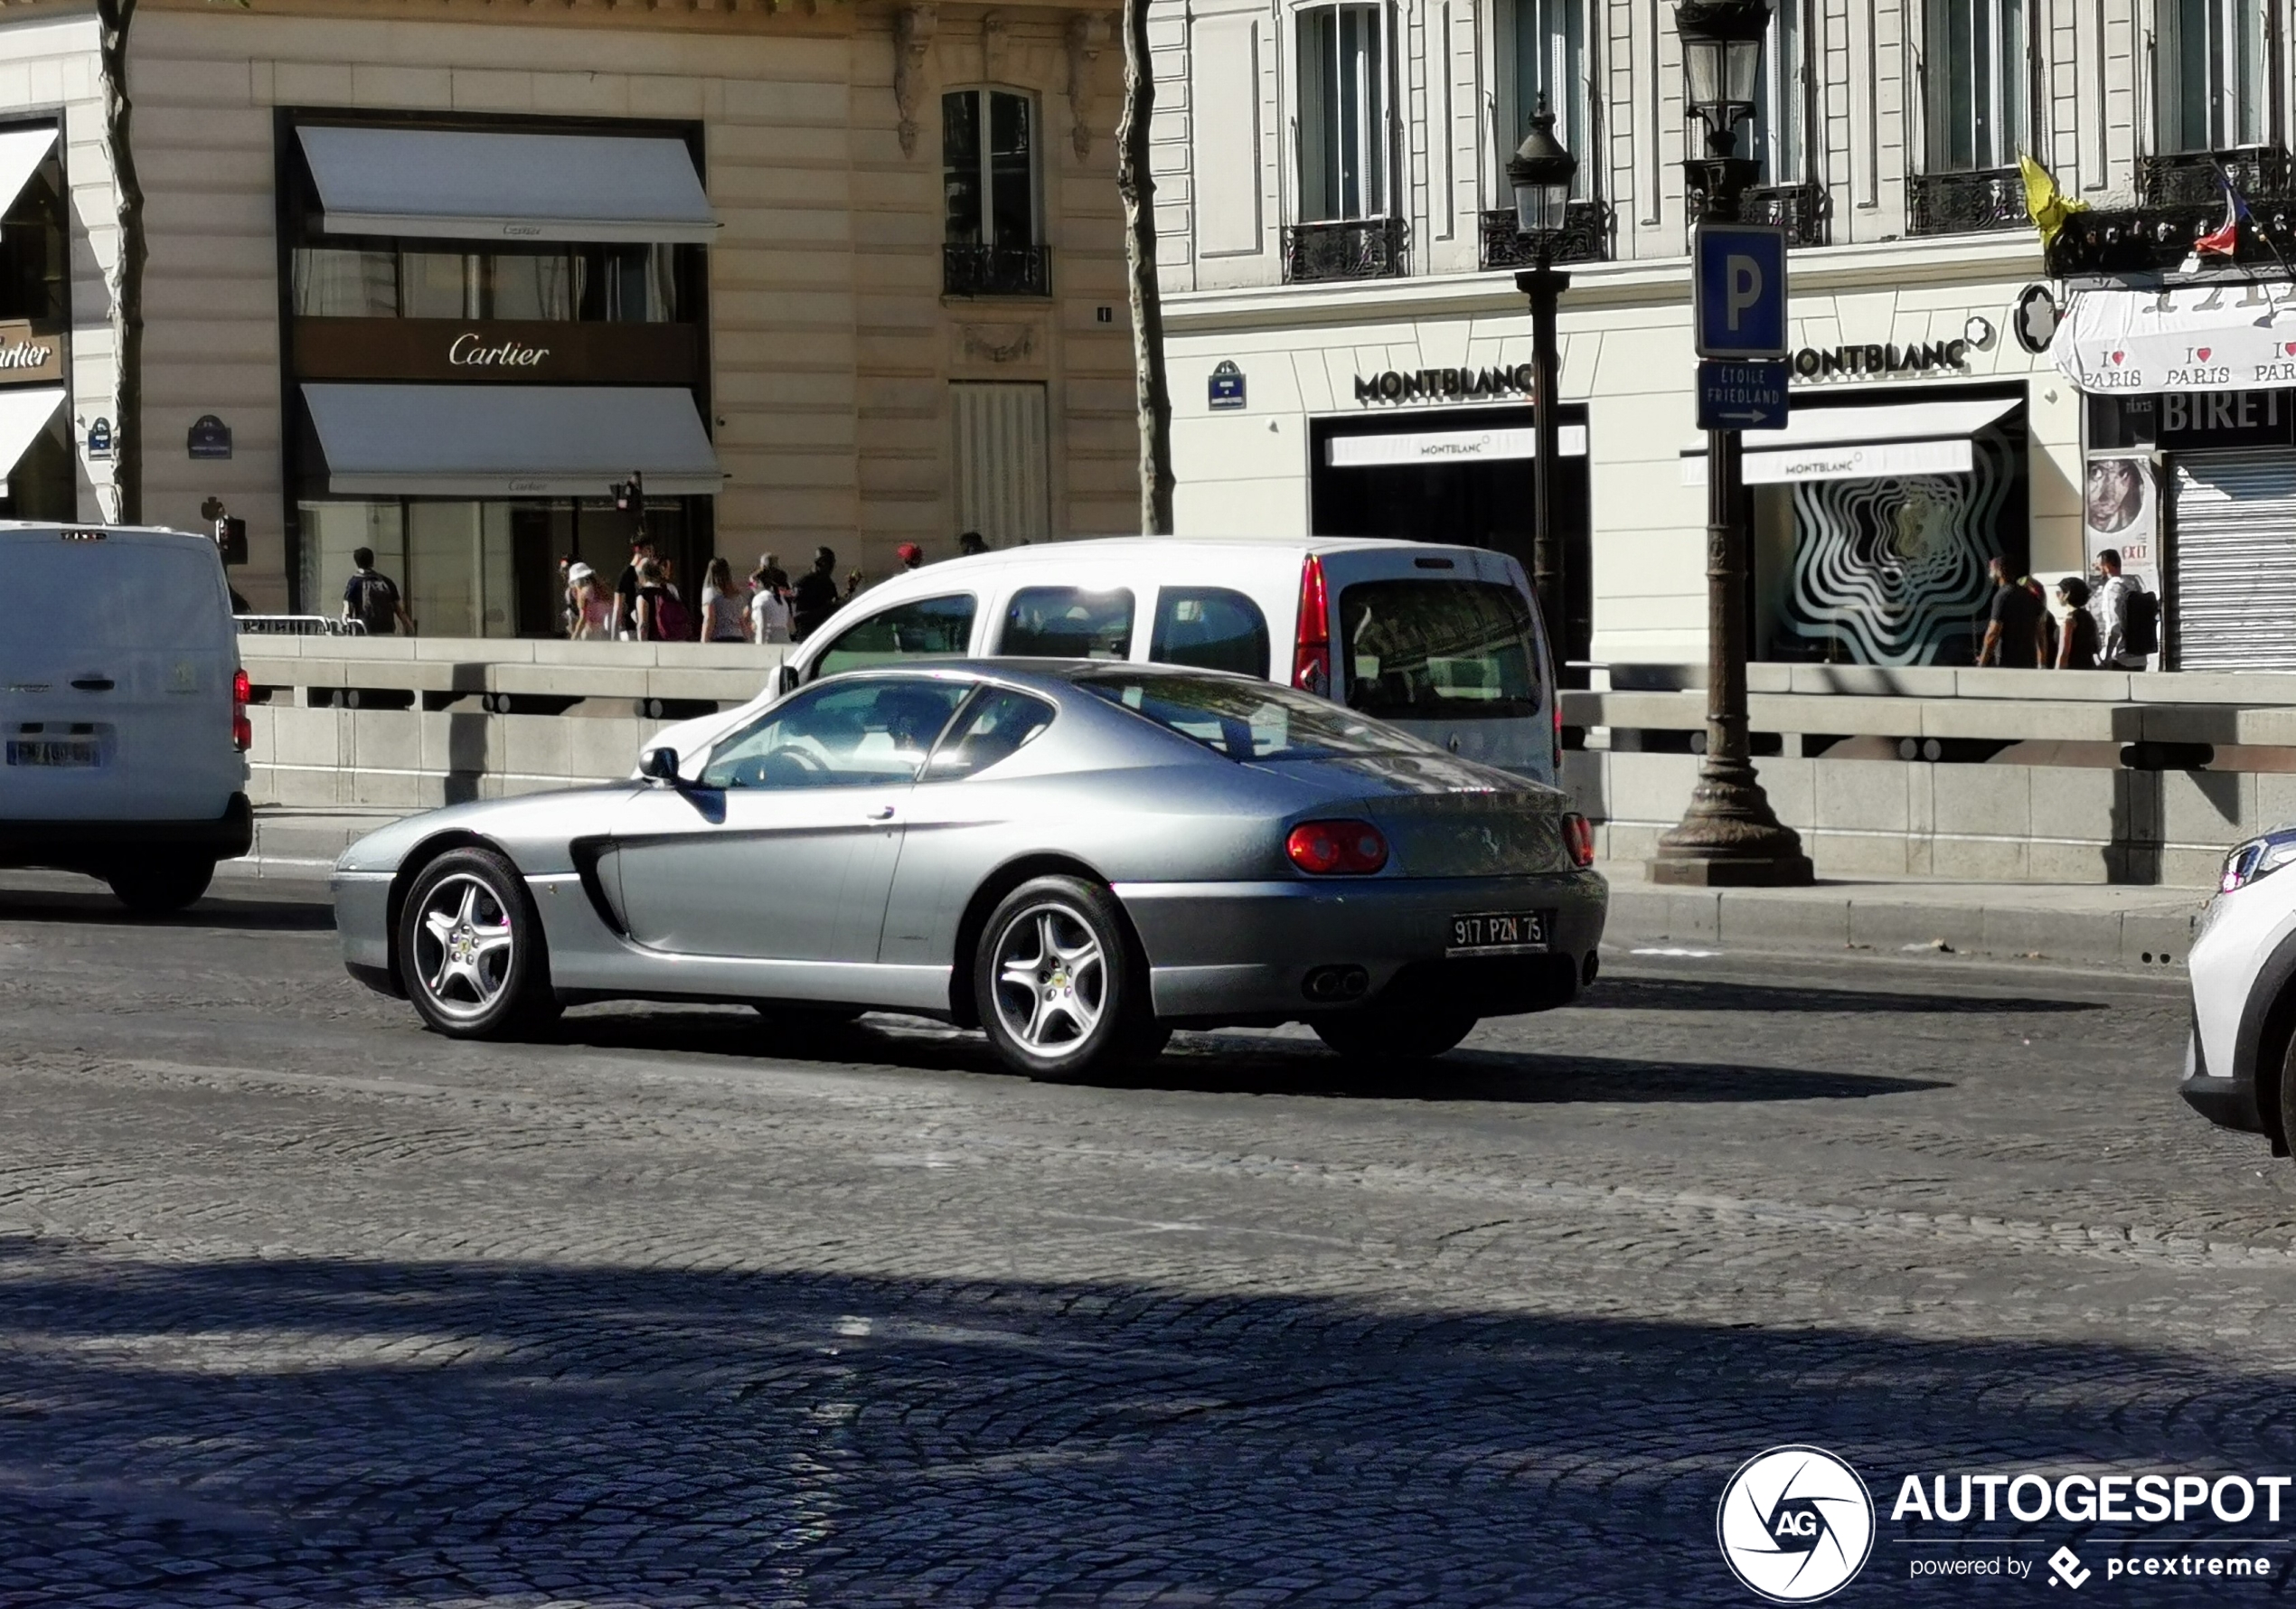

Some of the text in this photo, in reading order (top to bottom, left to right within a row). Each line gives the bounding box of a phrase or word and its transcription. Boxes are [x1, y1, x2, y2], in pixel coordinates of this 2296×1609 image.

[1727, 254, 1763, 332] P
[449, 333, 550, 366] Cartier
[2186, 347, 2194, 364] I
[2273, 343, 2282, 359] I
[1354, 363, 1534, 400] MONTBLANC
[1721, 365, 1765, 383] ÉTOILE
[2081, 370, 2141, 388] PARIS
[2164, 367, 2230, 385] PARIS
[1421, 443, 1482, 455] MONTBLANC
[1785, 460, 1853, 475] MONTBLANC
[1455, 917, 1541, 944] 917 PZN 75
